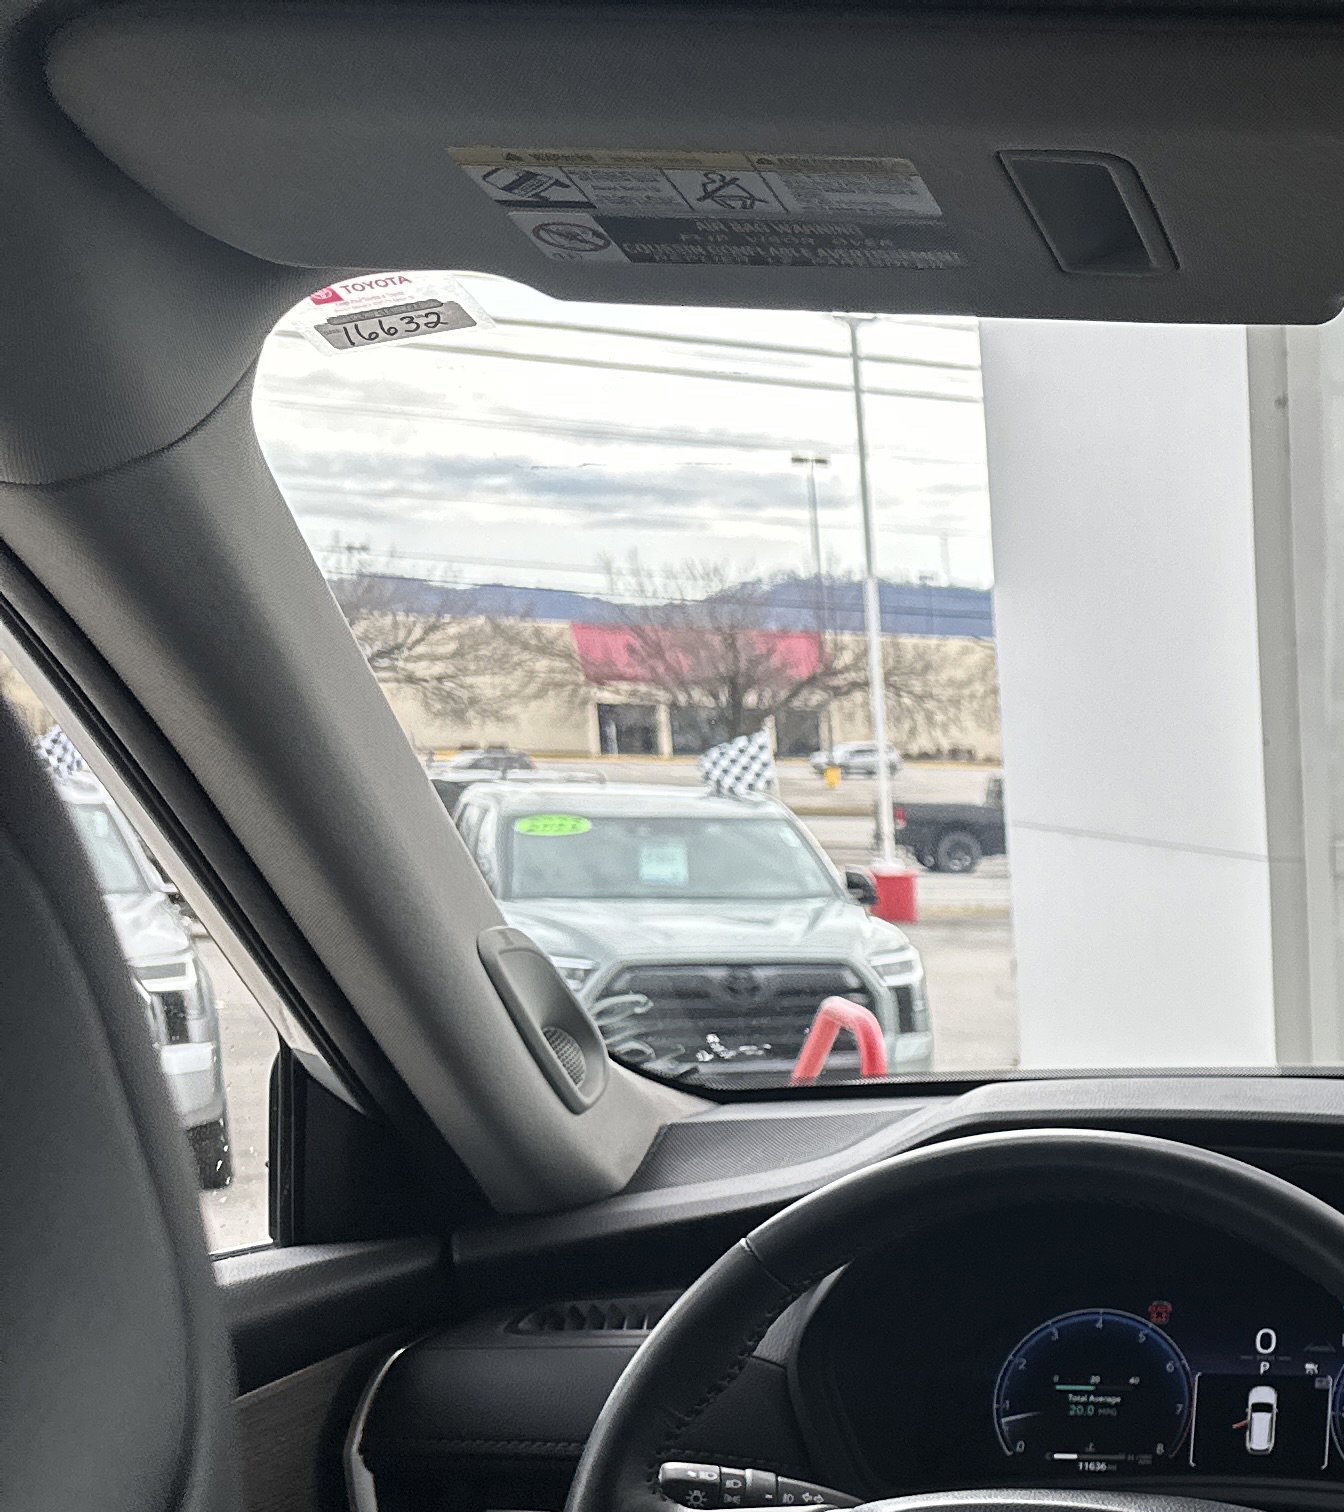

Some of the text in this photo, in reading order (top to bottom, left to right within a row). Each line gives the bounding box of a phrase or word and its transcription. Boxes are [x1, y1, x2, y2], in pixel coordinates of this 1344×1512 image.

[340, 275, 412, 294] TOYOTA
[343, 311, 448, 346] 16632
[1095, 1317, 1104, 1330] 4
[1051, 1328, 1060, 1341] 3
[1255, 1328, 1277, 1354] 0
[1017, 1359, 1027, 1371] 2
[1165, 1361, 1175, 1373] 6
[1259, 1362, 1271, 1375] P
[1068, 1394, 1122, 1405] Total Average
[1068, 1404, 1095, 1417] 20.0
[1015, 1440, 1026, 1453] 0
[1155, 1442, 1165, 1455] 8
[1078, 1461, 1107, 1472] 11636
